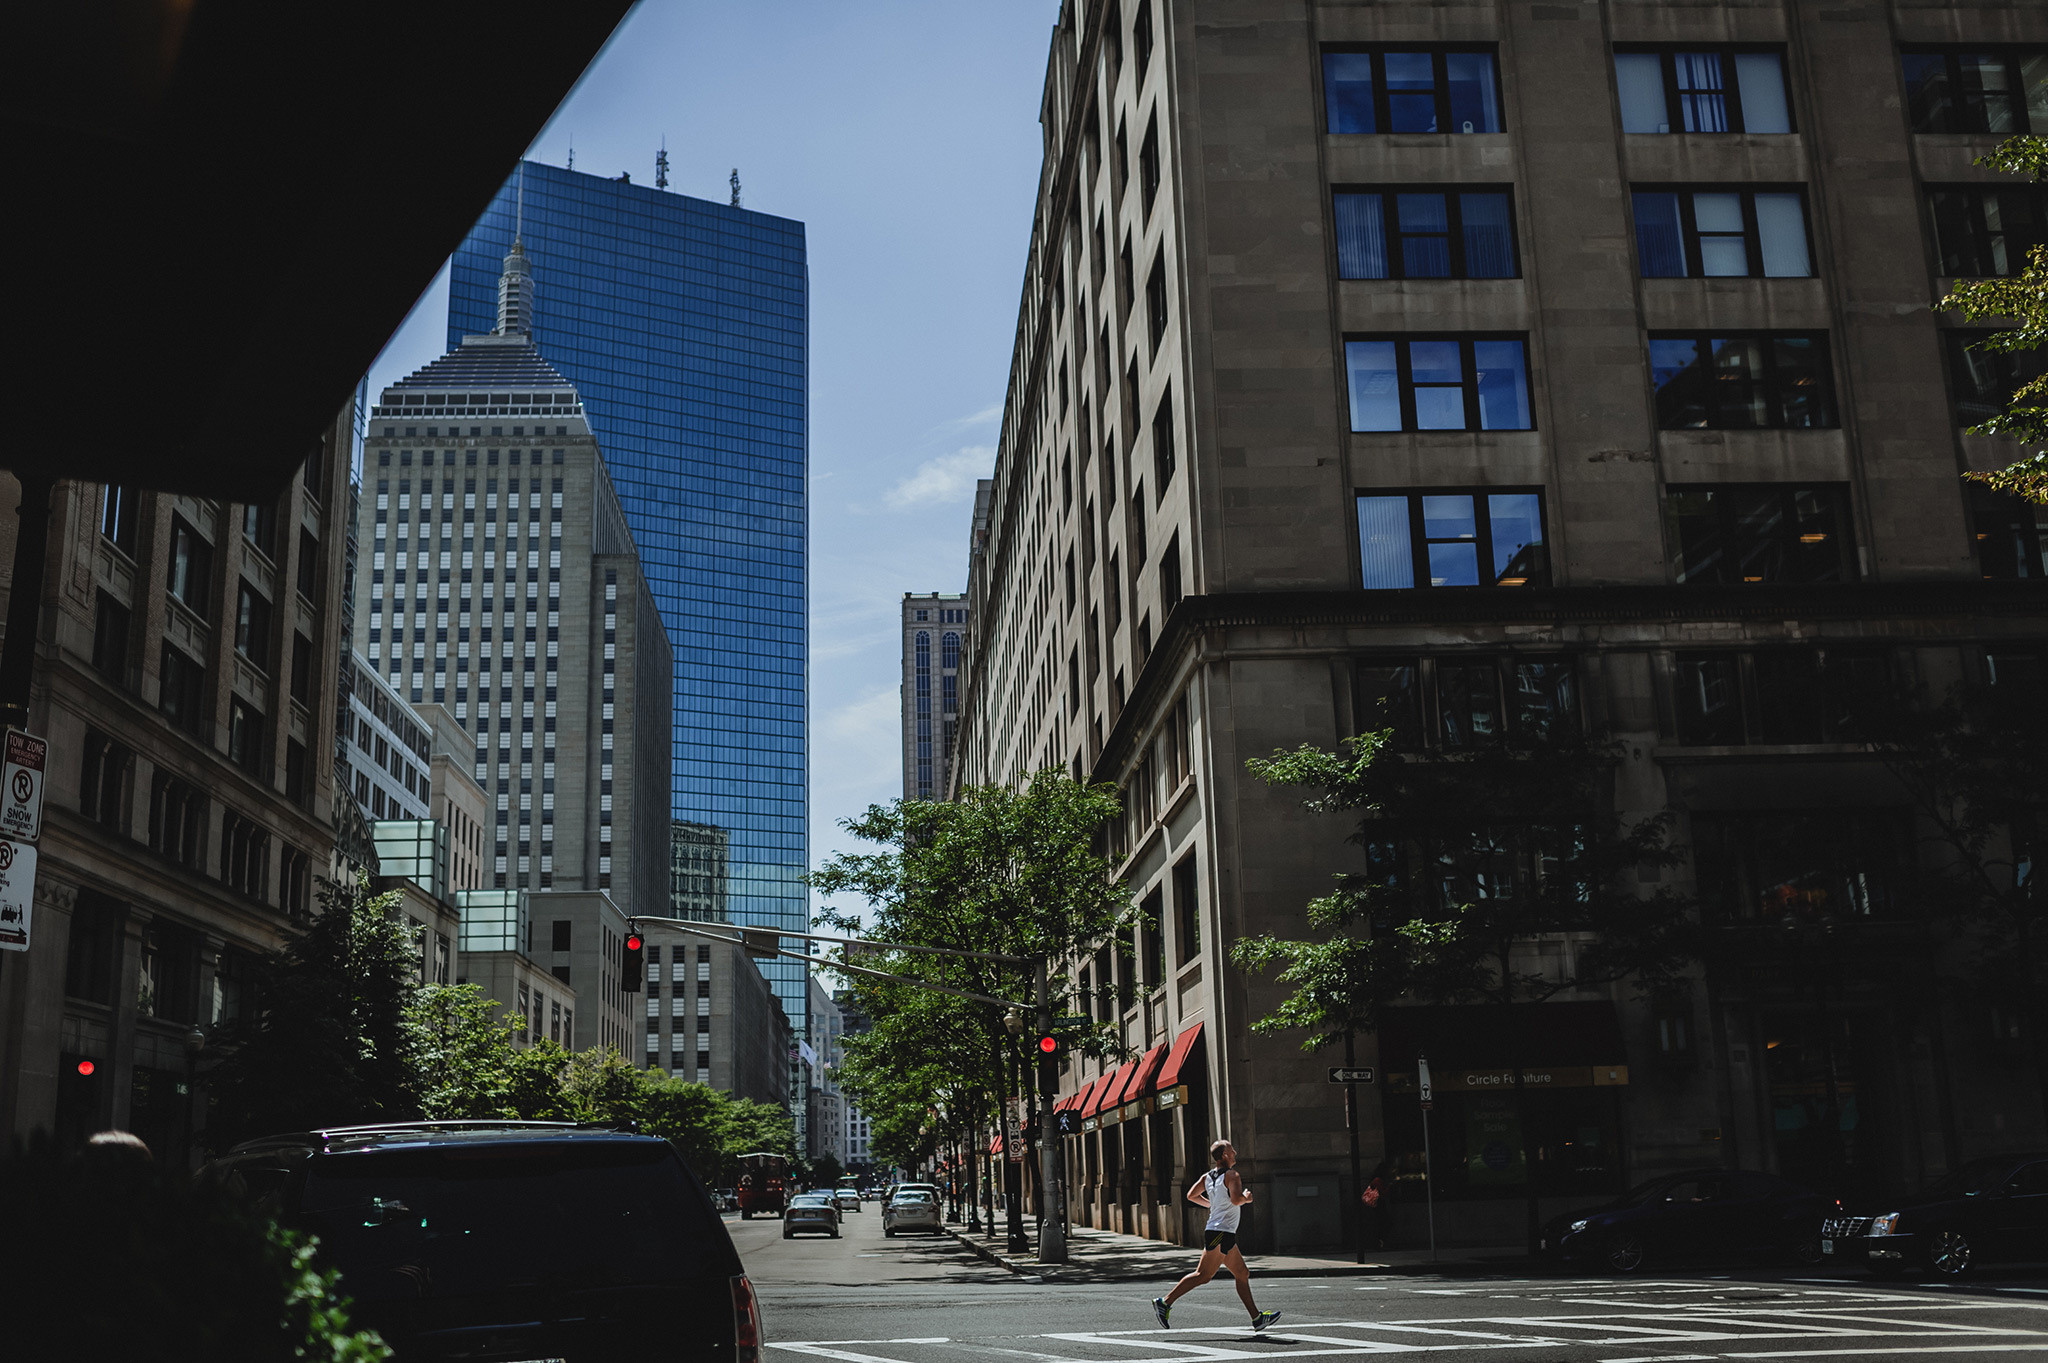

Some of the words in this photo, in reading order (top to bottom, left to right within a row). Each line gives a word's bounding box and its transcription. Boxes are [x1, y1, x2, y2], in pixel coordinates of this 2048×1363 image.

[9, 734, 24, 748] TOW
[27, 740, 45, 756] ZONE
[10, 747, 41, 761] EMERGENCY
[14, 802, 27, 810] during
[7, 808, 32, 822] SNOW
[3, 817, 33, 830] EMERGENCY
[1341, 1071, 1351, 1079] ONE
[1354, 1071, 1368, 1079] WAY
[1467, 1074, 1500, 1085] Circle
[1503, 1073, 1551, 1084] Funiture
[1484, 1122, 1506, 1132] Sale
